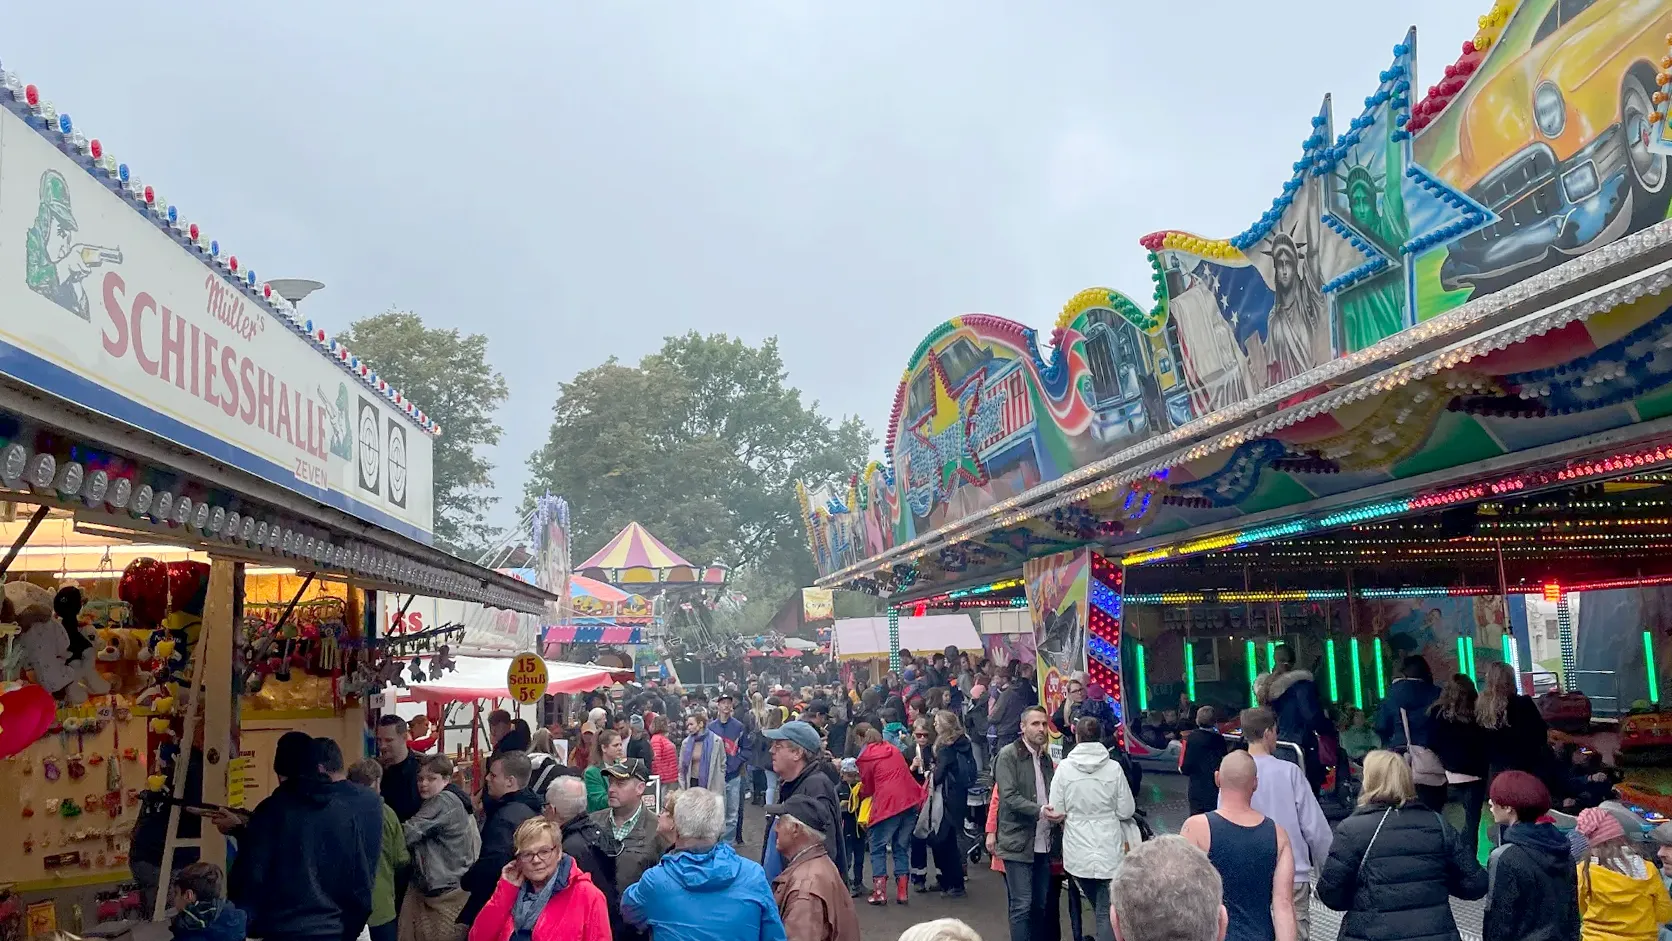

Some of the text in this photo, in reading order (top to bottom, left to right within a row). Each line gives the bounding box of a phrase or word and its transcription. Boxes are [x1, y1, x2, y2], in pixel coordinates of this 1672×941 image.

[205, 273, 265, 342] Müller's
[101, 271, 328, 462] SCHIESSHALLE
[295, 457, 328, 488] ZEVEN
[518, 657, 536, 673] 15
[509, 673, 546, 685] Schuß
[520, 686, 536, 702] 5€
